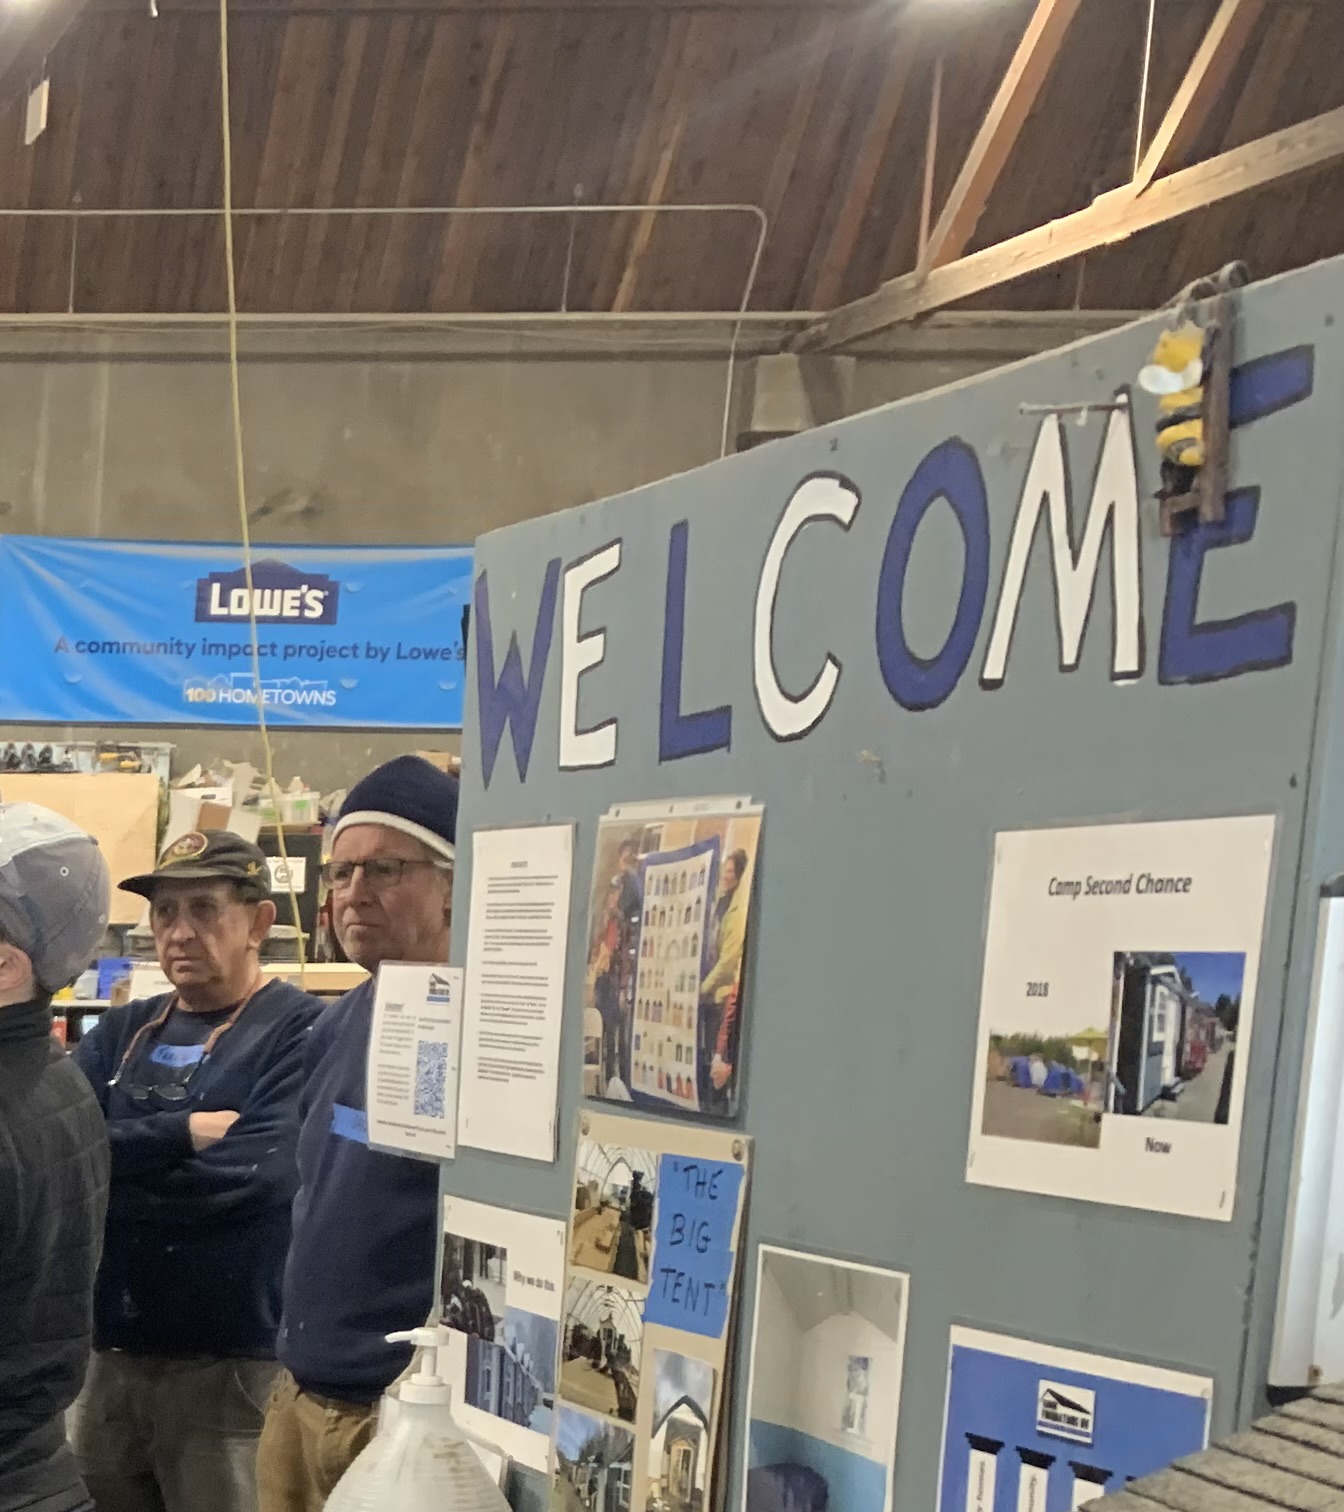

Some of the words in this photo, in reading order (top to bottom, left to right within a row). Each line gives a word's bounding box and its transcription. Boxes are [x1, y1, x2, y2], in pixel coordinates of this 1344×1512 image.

[475, 344, 1315, 790] WELCOME
[210, 583, 324, 619] LOWE'S
[54, 636, 69, 654] A
[74, 637, 196, 660] community
[202, 637, 278, 664] impact
[283, 639, 359, 663] project
[366, 642, 390, 663] by
[396, 639, 465, 662] Lowe's
[185, 687, 216, 703] 100
[218, 688, 336, 707] HOMETOWNS
[1048, 876, 1081, 901] Camp
[1084, 873, 1134, 897] Second
[1136, 872, 1193, 896] Chance
[1026, 981, 1050, 998] 2018
[1145, 1136, 1172, 1154] Now
[669, 1212, 712, 1254] BIG
